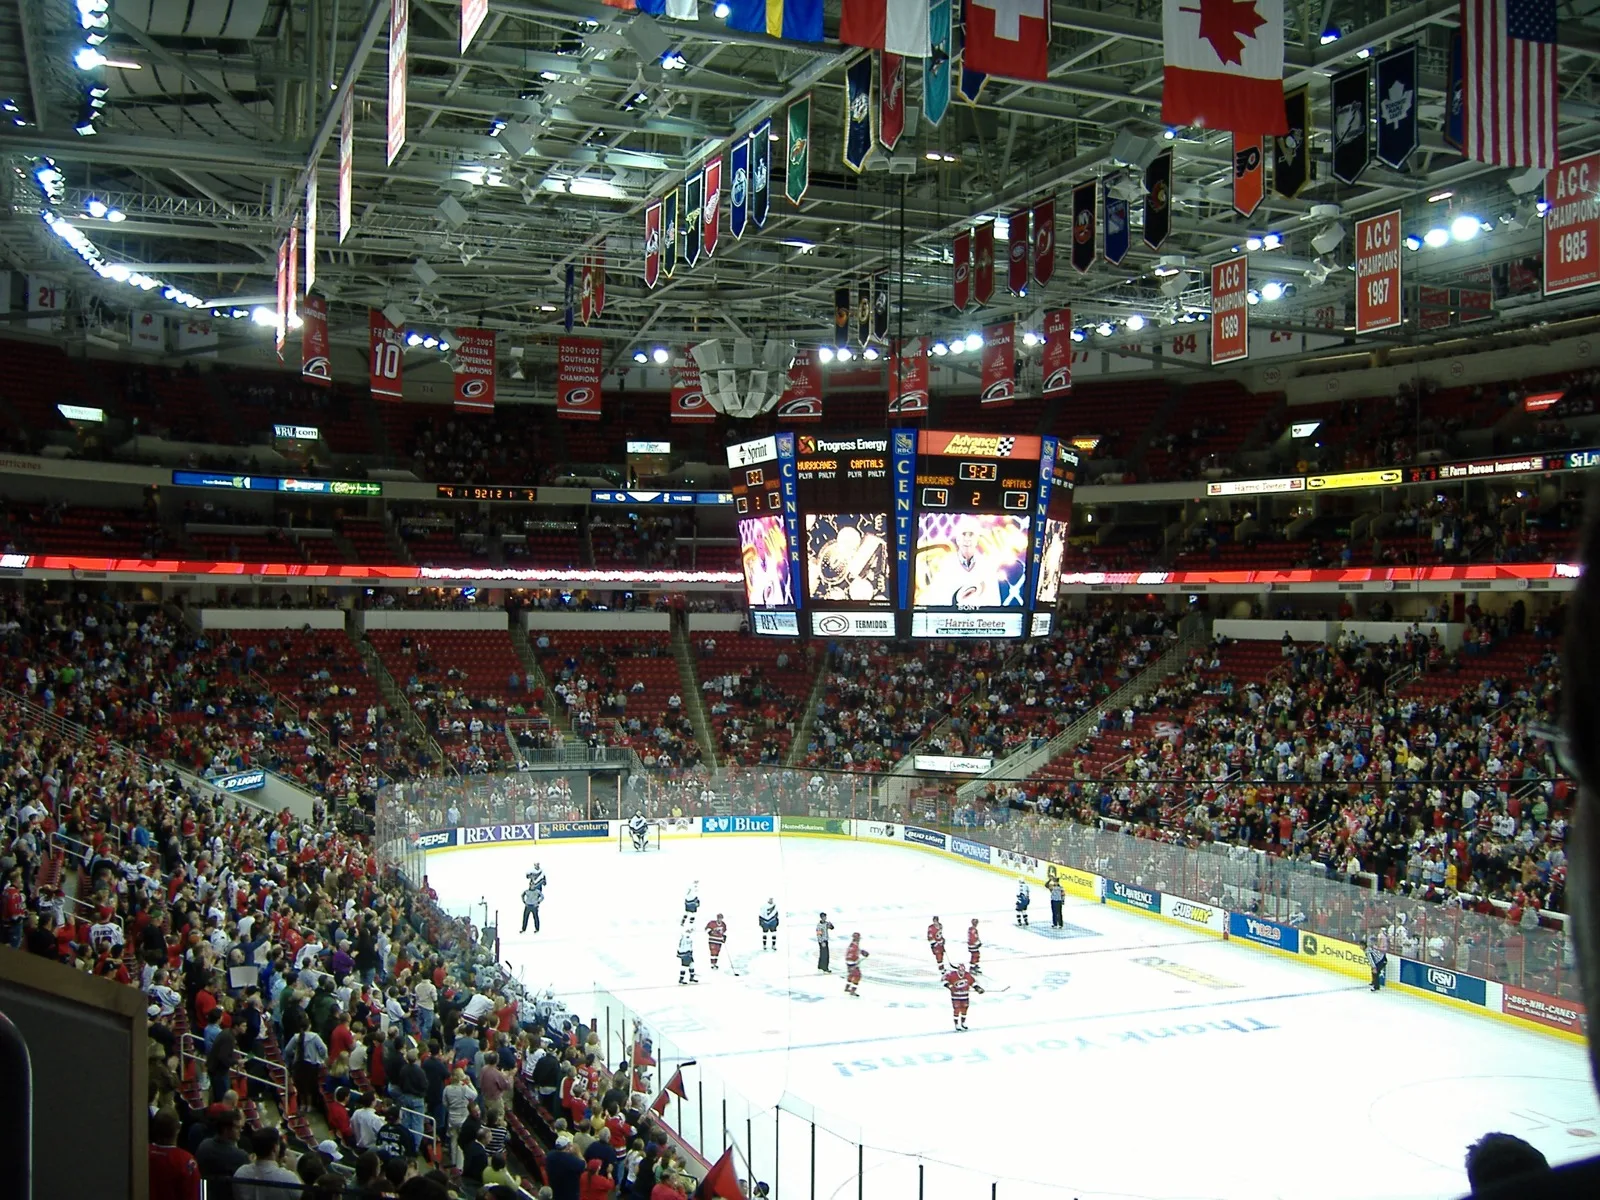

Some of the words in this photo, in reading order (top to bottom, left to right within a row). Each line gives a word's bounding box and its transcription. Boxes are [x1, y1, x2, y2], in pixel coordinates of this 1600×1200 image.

[1556, 162, 1590, 200] ACC
[1547, 197, 1600, 231] CHAMPIONS
[1365, 225, 1392, 252] ACC
[1558, 229, 1588, 264] 1985
[1357, 250, 1398, 278] CHAMPIONS
[1218, 263, 1240, 291] ACC
[38, 286, 56, 309] 21
[1367, 277, 1390, 307] 1987
[1213, 289, 1245, 315] CHAMPIONS
[1049, 324, 1065, 334] STAAL
[1220, 314, 1239, 340] 1989
[461, 346, 489, 357] EASTERN
[561, 345, 600, 356] 2001-2002
[1172, 334, 1198, 355] 84
[375, 342, 399, 379] 10
[456, 353, 493, 366] CONFERENCE
[560, 355, 600, 365] SOUTHEAST
[464, 364, 493, 376] AMPIONS
[564, 365, 595, 374] DIVISION
[559, 374, 600, 384] CHAMPIONS
[817, 439, 856, 453] Progress
[856, 438, 888, 452] Energy
[950, 434, 997, 448] Advance
[747, 442, 768, 464] Sprint
[943, 444, 969, 455] Auto
[968, 445, 995, 456] Parts
[797, 460, 838, 471] HURRICANES
[850, 459, 884, 470] CAPITALS
[969, 464, 996, 479] 9:21
[1449, 466, 1467, 477] Farm
[1468, 463, 1494, 475] Bureau
[1494, 460, 1531, 473] Insurance
[798, 472, 813, 480] PLYR
[818, 471, 836, 479] PNLTY
[847, 471, 863, 479] PLYR
[867, 470, 886, 478] PNLTY
[916, 475, 955, 486] HURRICANES
[1002, 479, 1032, 489] CAPITALS
[1235, 482, 1261, 492] Harris
[1262, 481, 1287, 491] Teeter
[936, 491, 946, 505] 4
[971, 492, 981, 506] 2
[1017, 494, 1026, 507] 2
[782, 463, 800, 563] CENTER
[897, 460, 911, 562] CENTER
[1033, 466, 1051, 564] CENTER
[761, 614, 779, 631] REX
[855, 620, 888, 630] TERMIDOR
[944, 618, 975, 629] Harris
[976, 618, 1006, 628] Teeter
[237, 774, 264, 787] LIGHT
[552, 823, 572, 832] RBC
[572, 822, 609, 831] Centura
[735, 818, 770, 832] Blue
[781, 823, 824, 831] HostedSolutions
[870, 826, 885, 836] my
[418, 832, 450, 847] PEPSI
[466, 827, 497, 844] REX
[500, 823, 533, 842] REX
[908, 831, 926, 840] BUD
[925, 834, 945, 846] LIGHT
[952, 840, 990, 861] COMPUWARE
[1059, 872, 1075, 883] JOHN
[1074, 874, 1093, 888] DEERE
[1172, 901, 1214, 924] SUBWAY
[1246, 918, 1281, 941] Y102.9
[1319, 944, 1344, 960] JOHN
[1345, 950, 1370, 966] DEER
[1431, 970, 1452, 988] FSN
[1504, 993, 1578, 1021] 1-866-NHL-CANES
[1106, 1015, 1282, 1046] Thank
[999, 1034, 1108, 1058] You
[831, 1046, 992, 1078] Fans!
